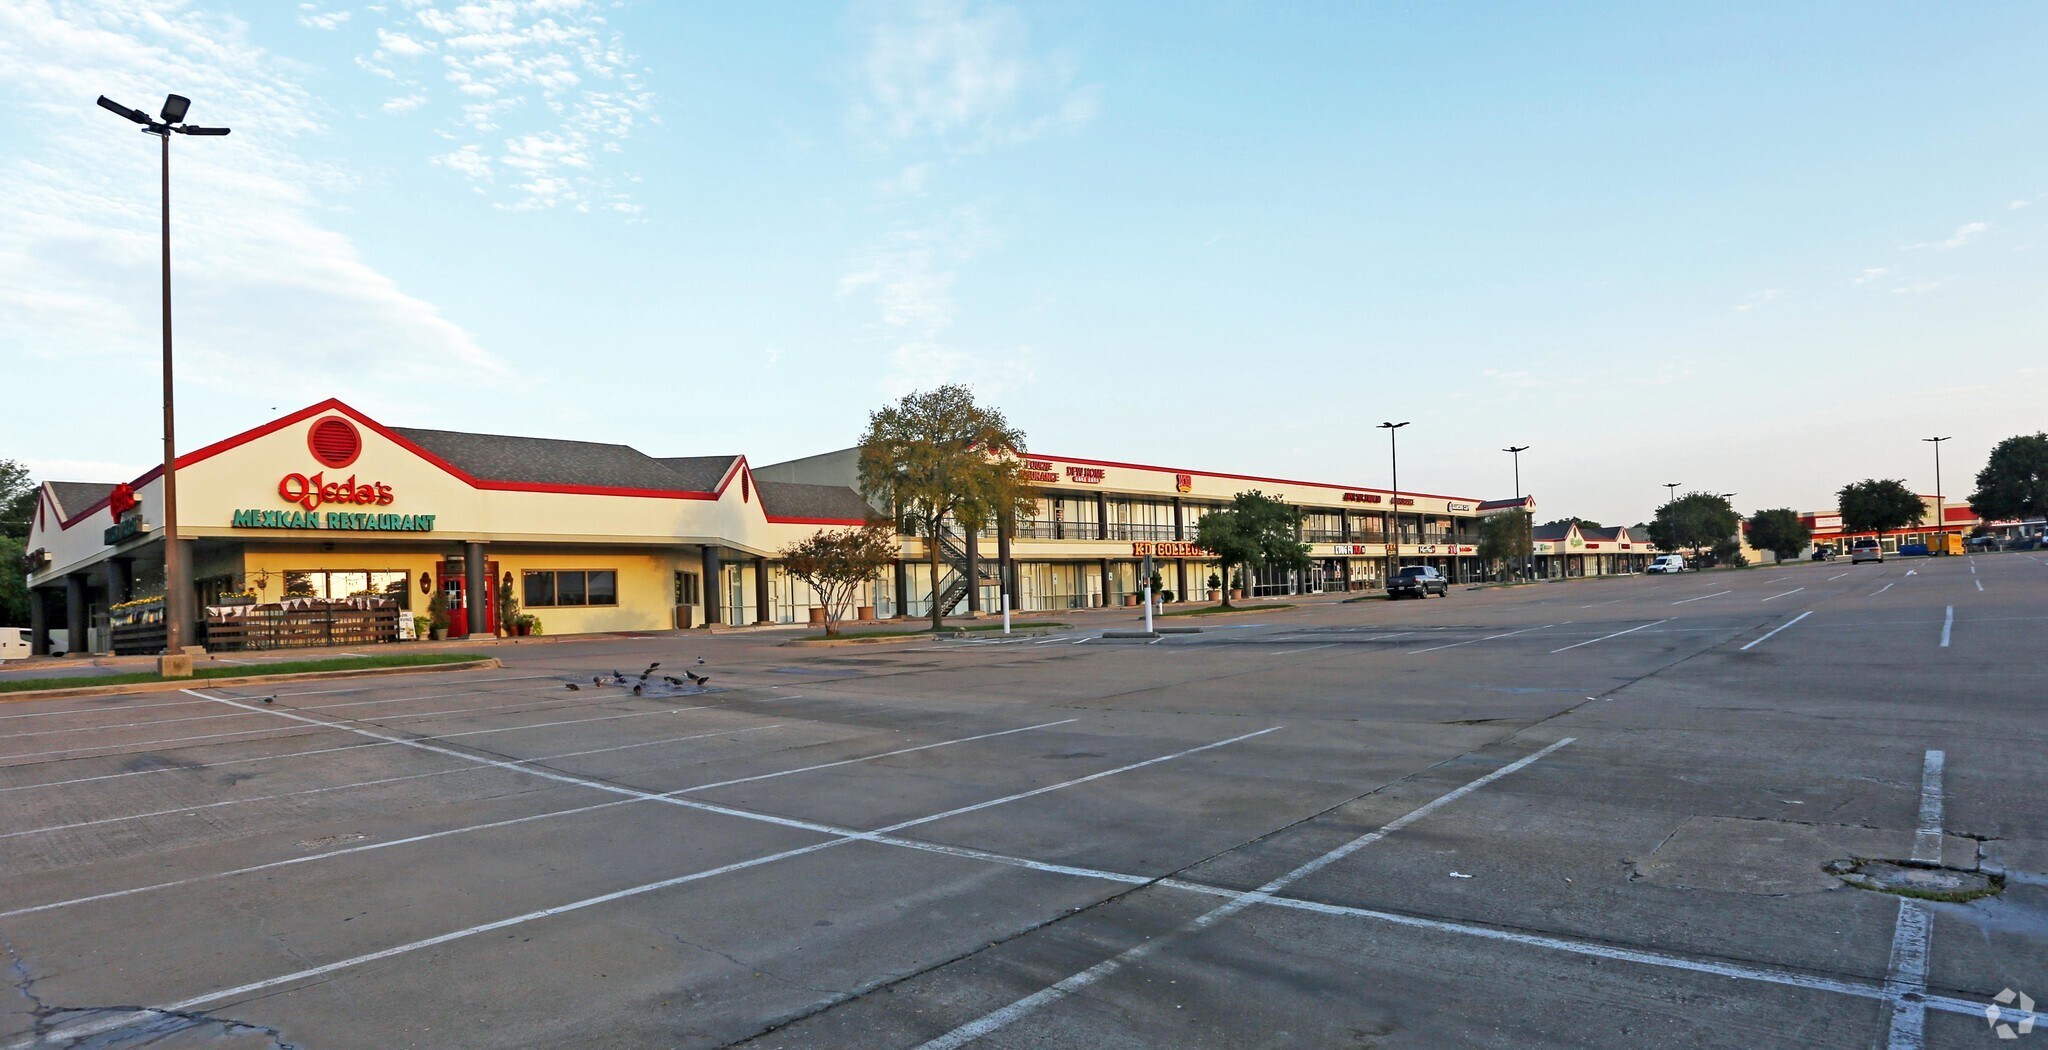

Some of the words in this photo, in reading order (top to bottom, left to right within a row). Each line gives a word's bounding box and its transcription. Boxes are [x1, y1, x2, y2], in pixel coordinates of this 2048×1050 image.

[232, 509, 320, 529] MEXICAN
[326, 512, 436, 532] RESTAURANT
[1133, 542, 1152, 556] KD
